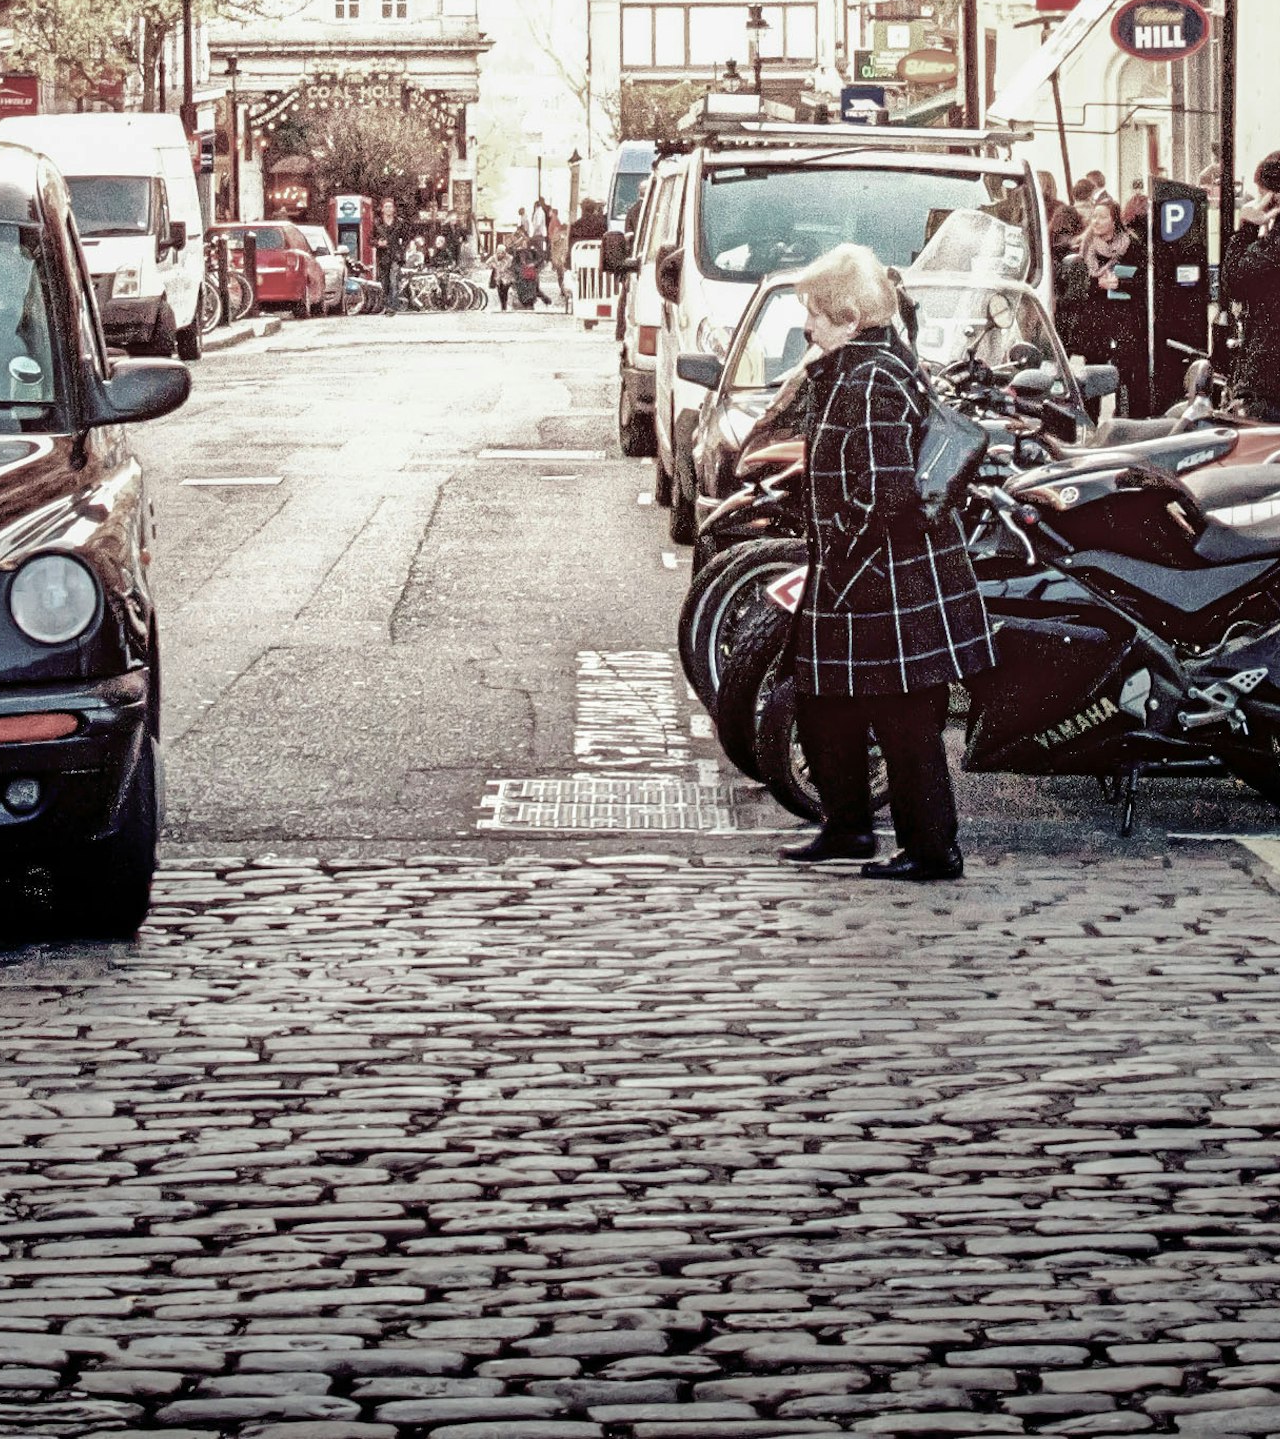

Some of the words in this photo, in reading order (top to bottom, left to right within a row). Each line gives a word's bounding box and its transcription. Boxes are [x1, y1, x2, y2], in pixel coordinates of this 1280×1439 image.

[1135, 25, 1186, 49] HILL
[1165, 204, 1185, 234] P
[1033, 697, 1119, 749] YAMAHA
